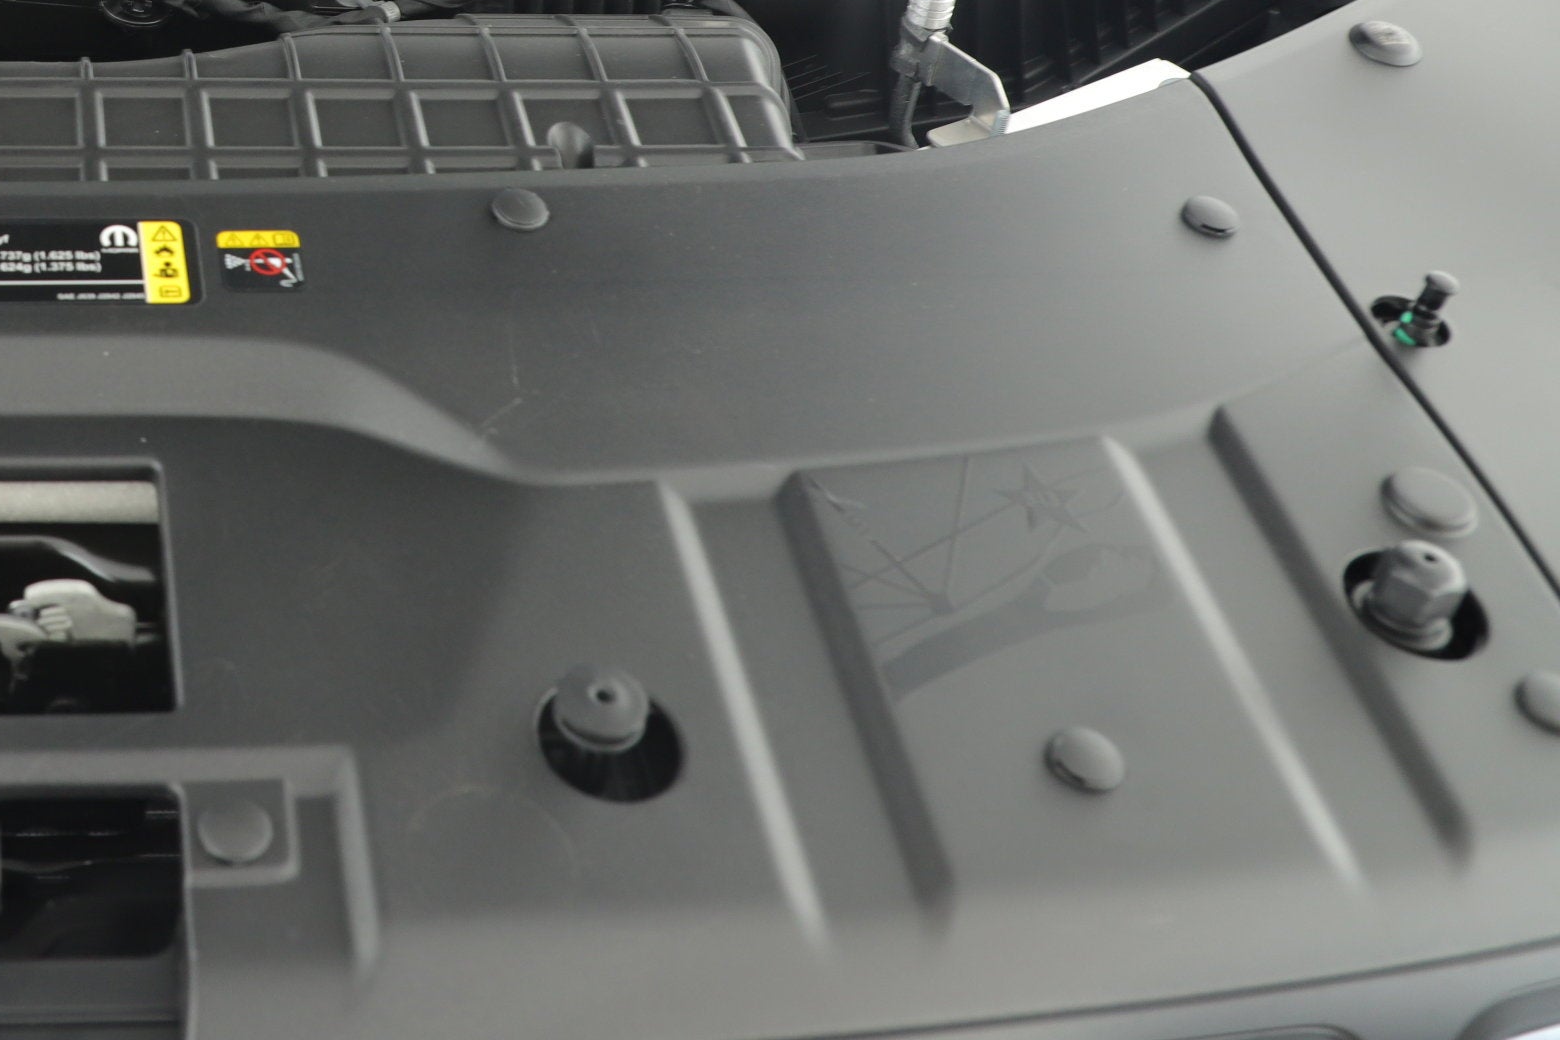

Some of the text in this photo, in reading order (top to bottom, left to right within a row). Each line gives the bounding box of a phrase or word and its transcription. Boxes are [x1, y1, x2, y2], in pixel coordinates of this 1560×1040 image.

[0, 250, 32, 262] 737g
[33, 250, 74, 262] (1.625
[75, 250, 102, 262] lbs)
[76, 262, 103, 273] lbs)
